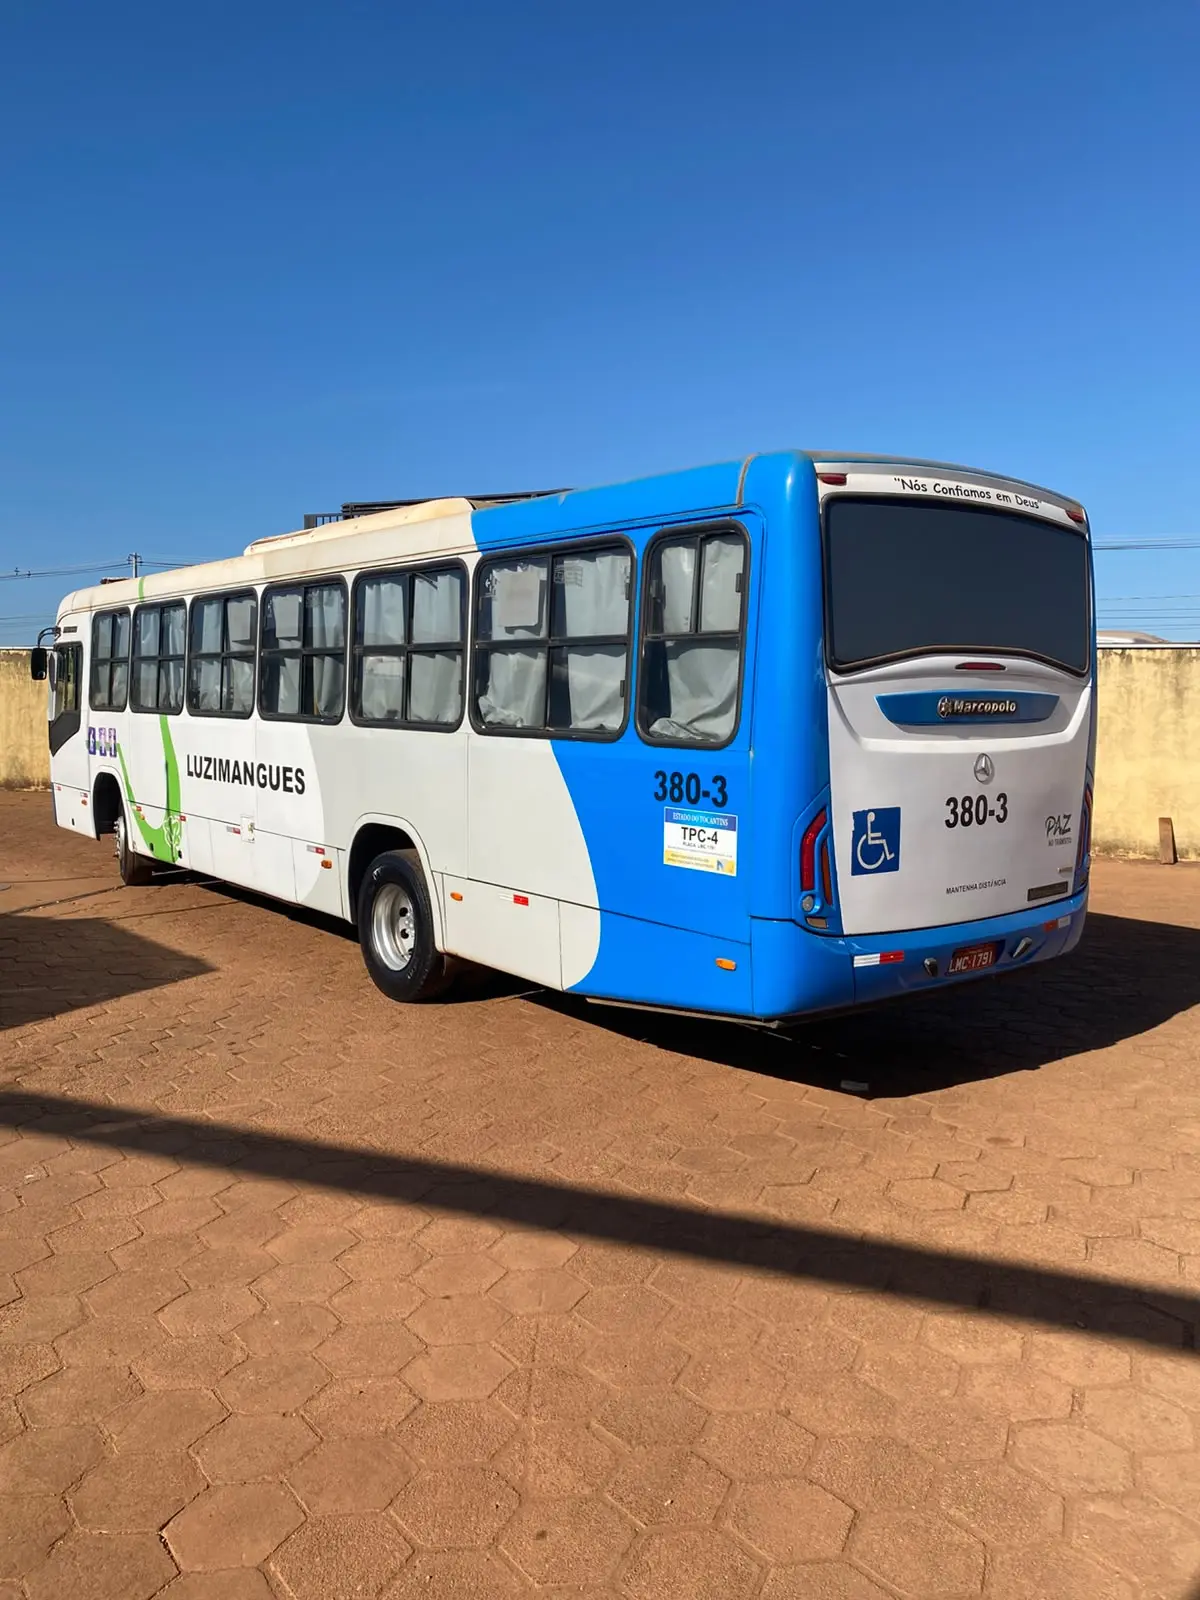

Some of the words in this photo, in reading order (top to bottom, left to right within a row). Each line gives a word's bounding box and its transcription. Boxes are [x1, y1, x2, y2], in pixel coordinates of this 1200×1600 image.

[933, 483, 991, 499] Confiamos
[996, 493, 1011, 503] em
[954, 700, 1016, 713] Marcopolo
[186, 754, 306, 795] LUZIMANGUES
[653, 769, 728, 808] 380-3
[673, 812, 691, 821] ESTADO
[699, 815, 728, 827] TOCANTINS
[945, 793, 1008, 828] 380-3
[681, 826, 719, 845] TPC-4
[1045, 813, 1072, 838] PAZ
[946, 883, 978, 894] MANTENHA
